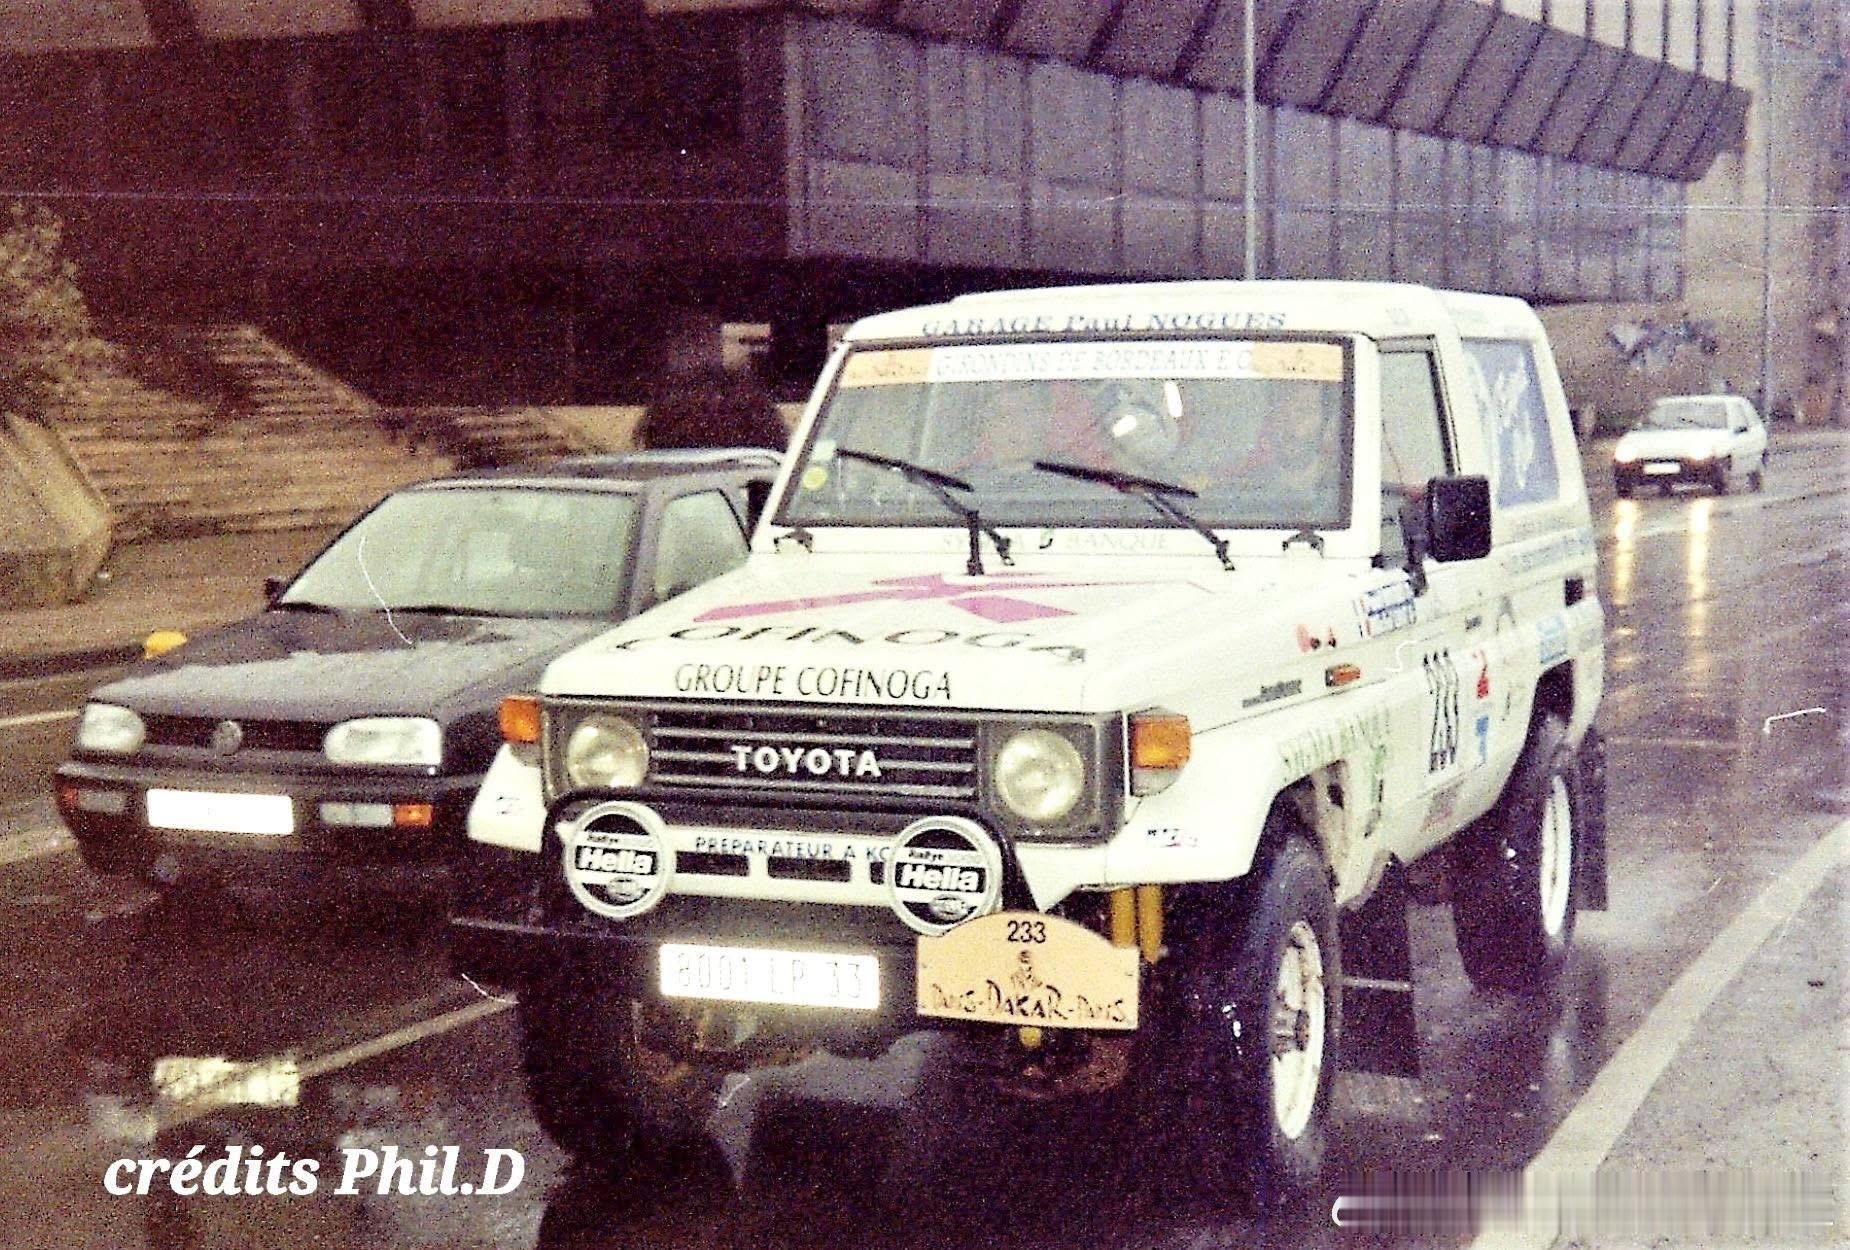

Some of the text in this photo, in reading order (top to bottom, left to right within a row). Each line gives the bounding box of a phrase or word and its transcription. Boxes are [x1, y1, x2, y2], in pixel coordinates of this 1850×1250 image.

[921, 312, 1287, 337] GARAGE Paul NOGUES
[1092, 350, 1208, 371] BORDEAUX
[615, 625, 1087, 665] COFINOGA
[674, 663, 952, 700] GROUPE COFINOGA
[731, 745, 882, 777] TOYOTA
[579, 847, 653, 871] Hella
[695, 836, 833, 860] PREPARATEUR
[900, 863, 980, 892] Hella
[1007, 920, 1047, 944] 233
